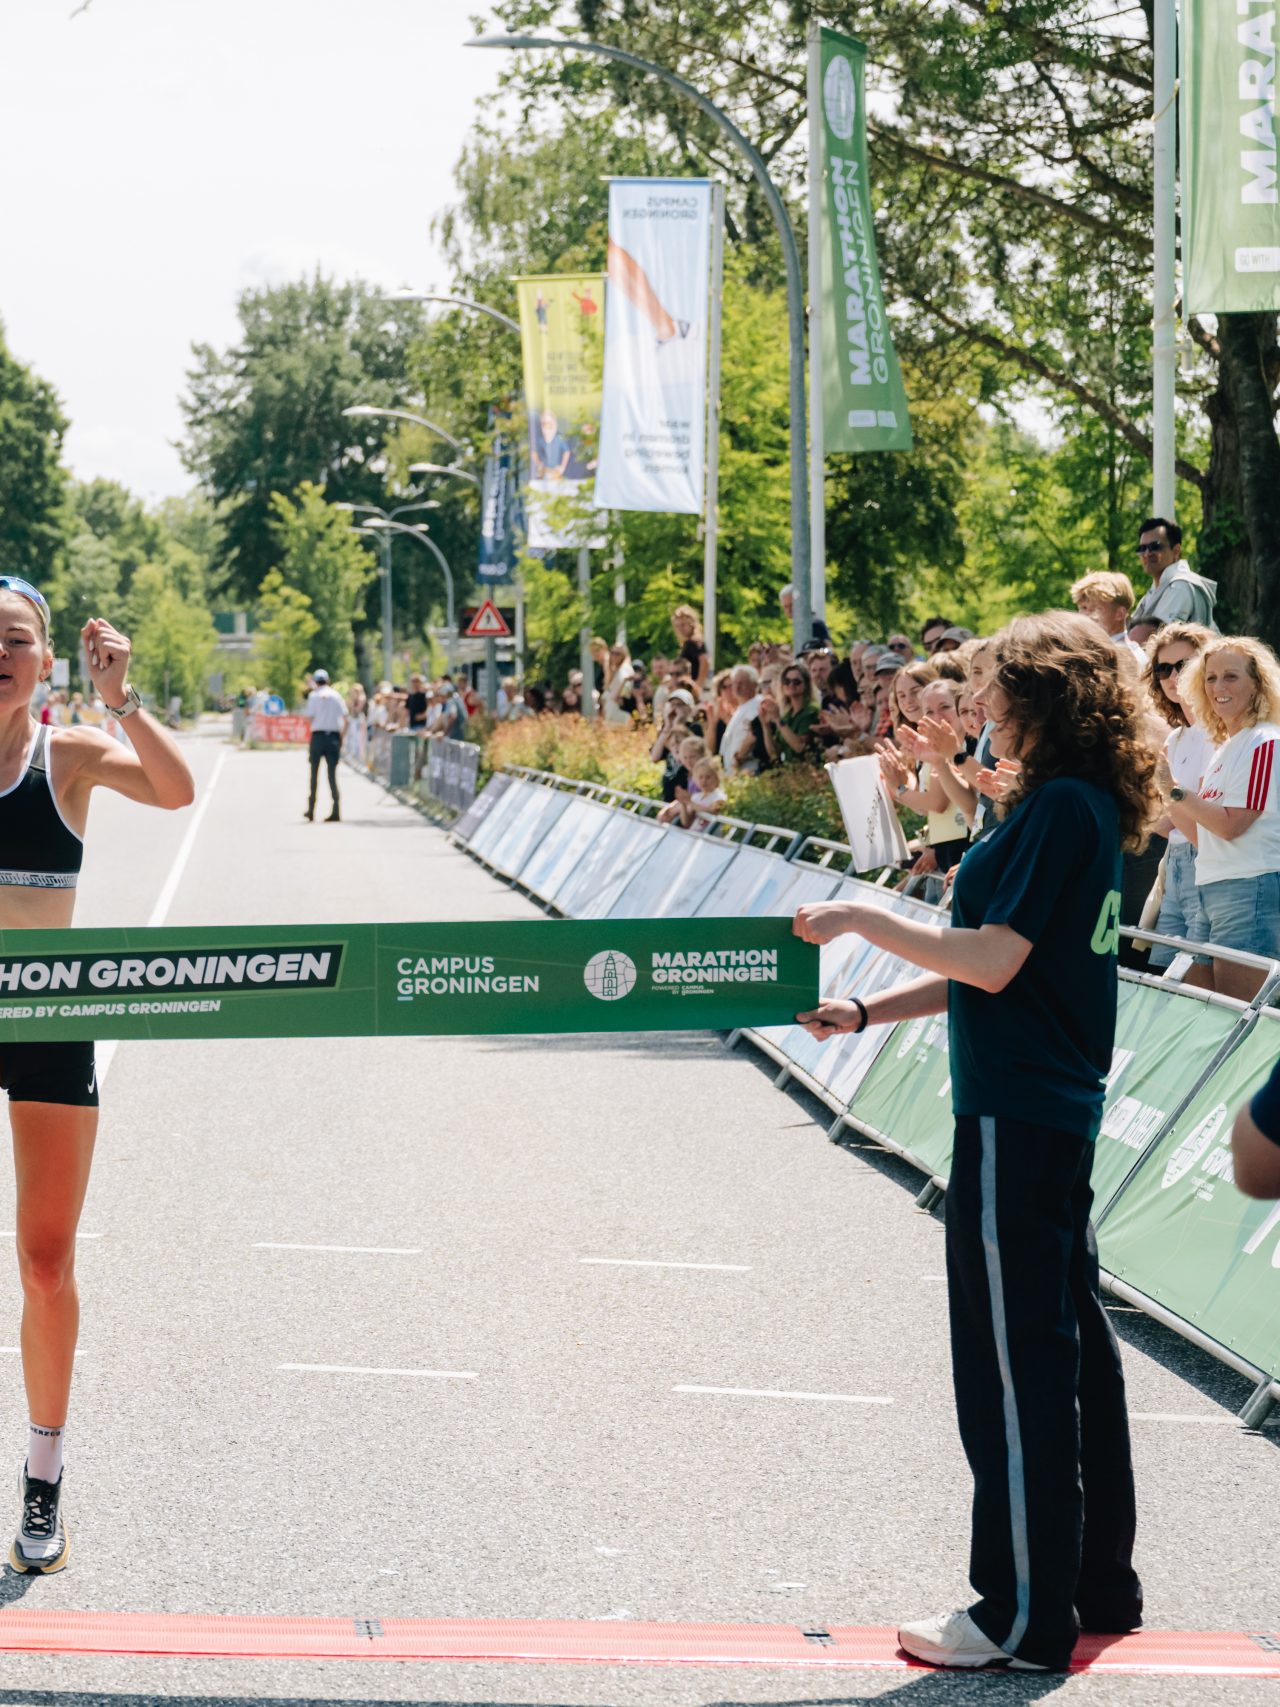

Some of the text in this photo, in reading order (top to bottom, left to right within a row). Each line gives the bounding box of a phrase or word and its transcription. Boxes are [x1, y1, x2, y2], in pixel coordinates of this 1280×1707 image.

[830, 155, 872, 385] MARATHON
[844, 159, 888, 385] GRONINGEN
[396, 956, 495, 975] CAMPUS
[651, 949, 778, 968] MARATHON
[87, 952, 333, 989] GRONINGEN
[651, 966, 778, 984] GRONINGEN
[396, 975, 540, 995] GRONINGEN
[34, 1004, 58, 1019] BY
[58, 1002, 127, 1018] CAMPUS
[127, 999, 222, 1016] GRONINGEN
